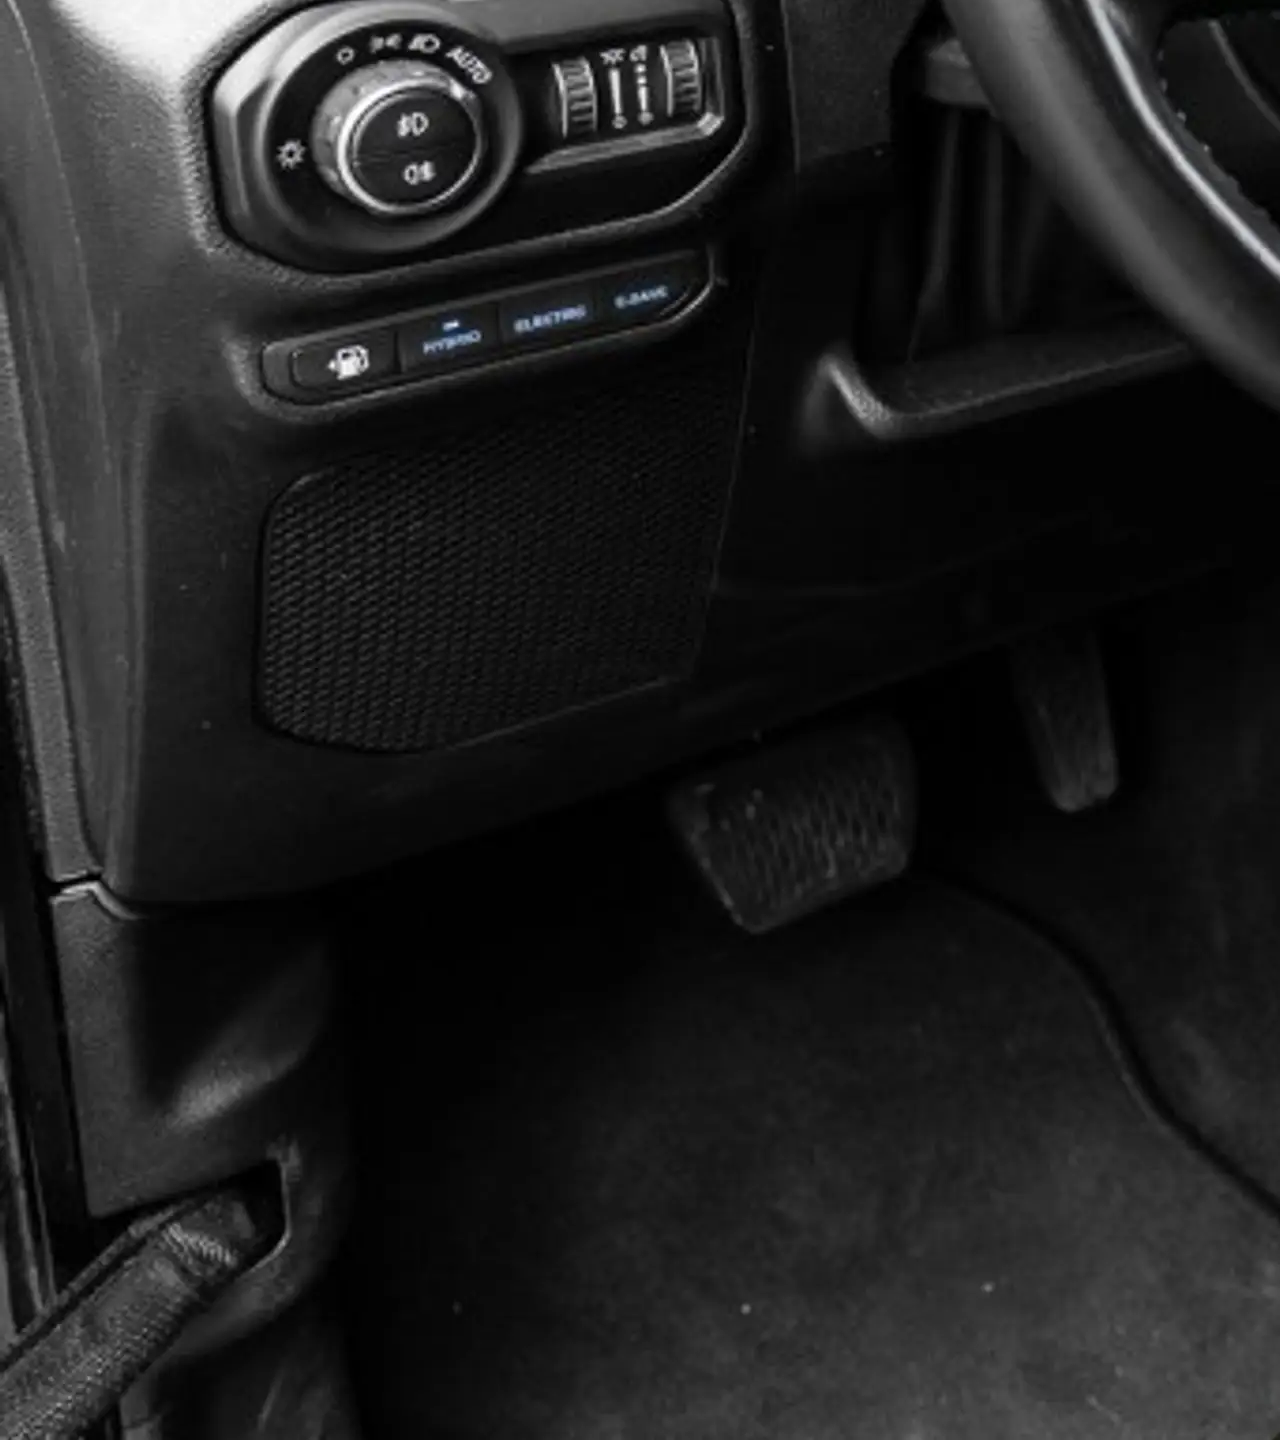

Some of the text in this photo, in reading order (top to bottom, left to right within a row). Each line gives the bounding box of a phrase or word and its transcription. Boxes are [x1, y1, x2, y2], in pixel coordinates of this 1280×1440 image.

[445, 45, 494, 86] AUTO
[514, 304, 588, 334] ELECTRIC
[422, 329, 483, 356] HYBRID
